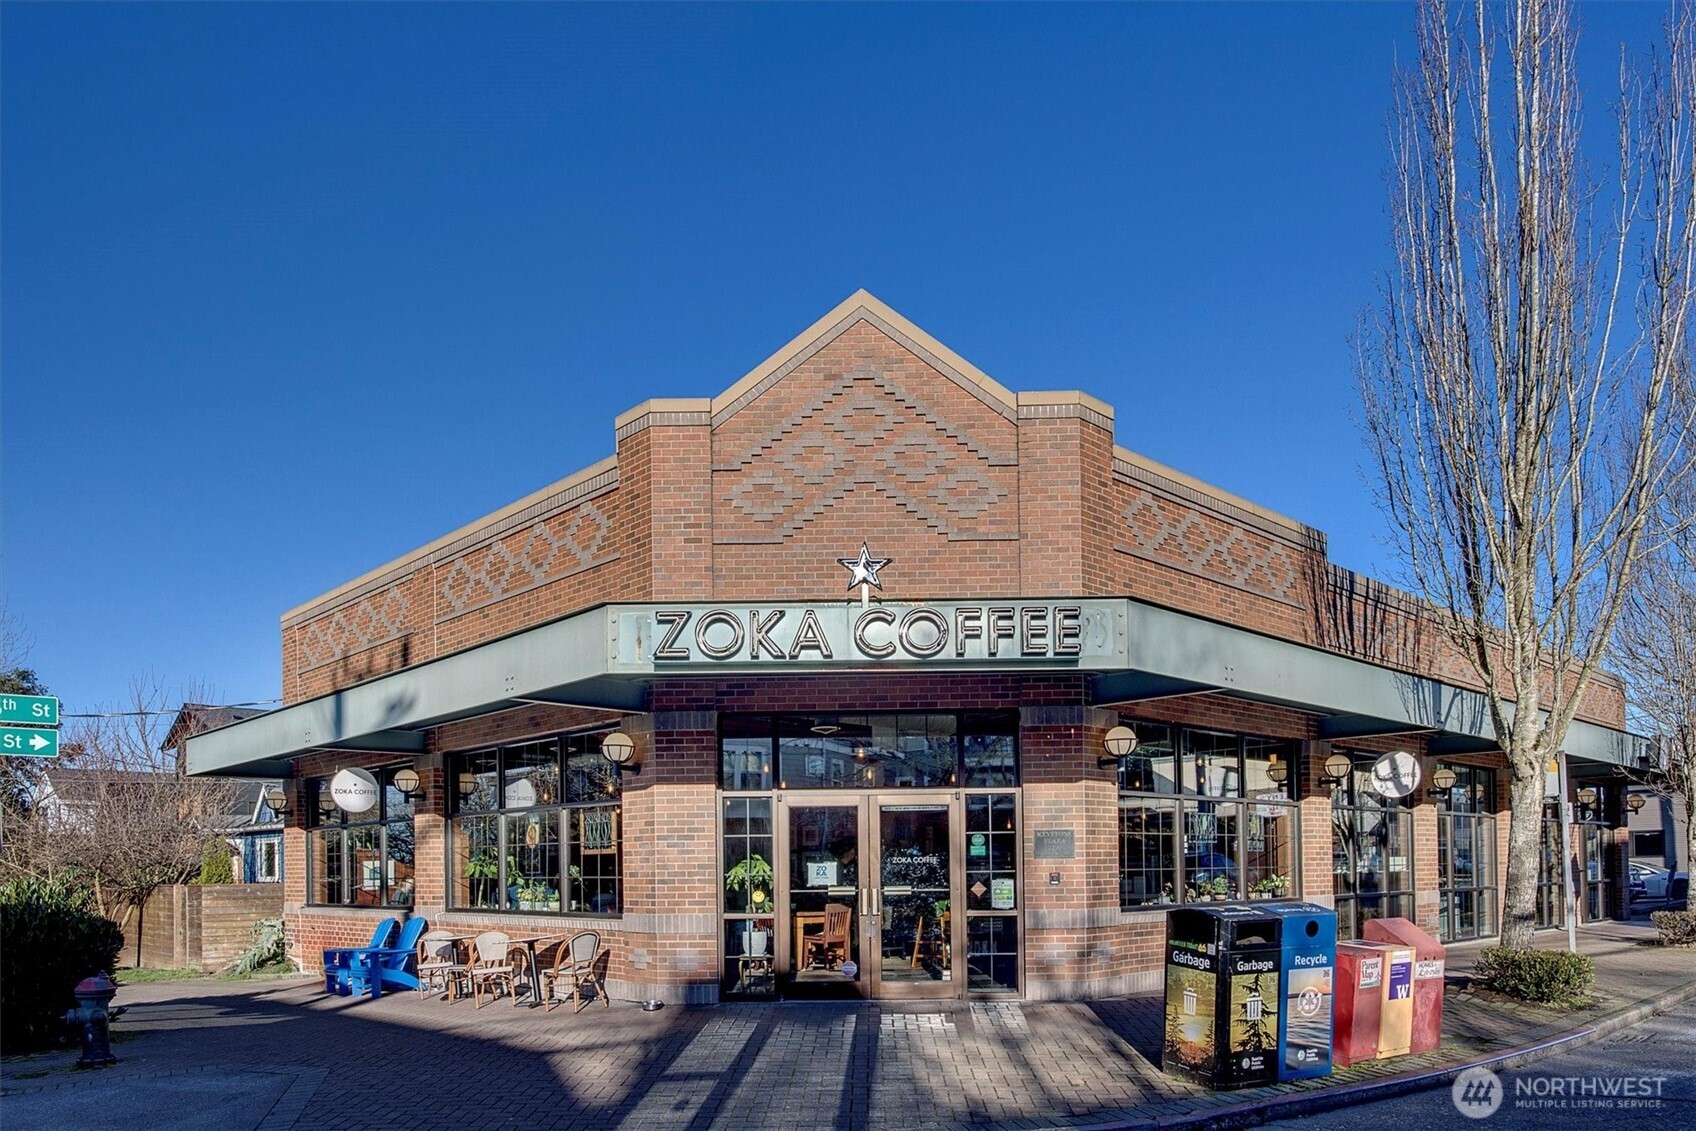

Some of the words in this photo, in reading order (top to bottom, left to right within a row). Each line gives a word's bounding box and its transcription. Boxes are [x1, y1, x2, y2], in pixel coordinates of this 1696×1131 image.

[653, 609, 834, 660] ZOKA
[853, 606, 1082, 659] COFFEE
[0, 698, 17, 715] th
[32, 703, 51, 717] St
[3, 734, 22, 749] St
[353, 788, 378, 796] COFFEE
[891, 856, 913, 864] ZOKA
[1172, 950, 1211, 969] Garbage
[1237, 960, 1274, 972] Garbage
[1294, 953, 1328, 966] Recycle
[1361, 960, 1379, 970] Parent
[1396, 984, 1410, 999] W
